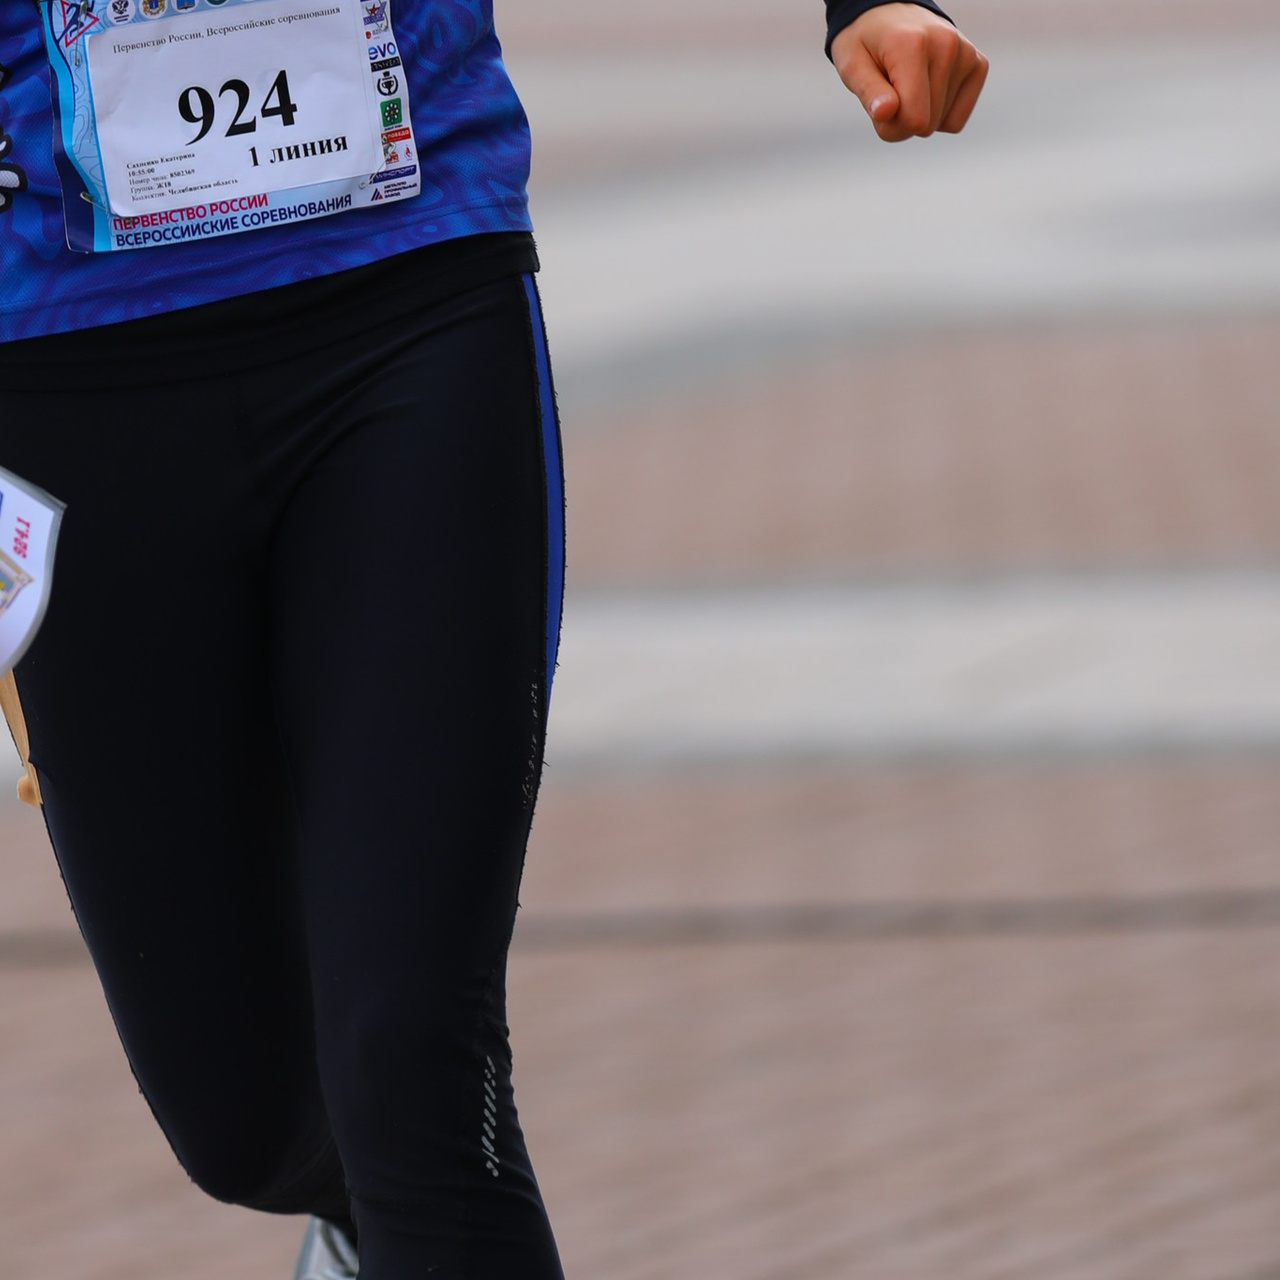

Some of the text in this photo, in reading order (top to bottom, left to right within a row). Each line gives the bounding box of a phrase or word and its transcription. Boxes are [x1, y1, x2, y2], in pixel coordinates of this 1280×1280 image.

[113, 6, 340, 54] Первенство России, Всероссийские соревнования
[368, 41, 397, 61] evo
[178, 69, 298, 146] 924
[160, 152, 196, 162] Екатерина
[248, 146, 260, 167] 1
[128, 167, 156, 177] 10:55:00
[113, 193, 269, 231] ПЕРВЕНСТВО РОССИИ
[241, 193, 352, 228] СОРЕВНОВАНИЯ
